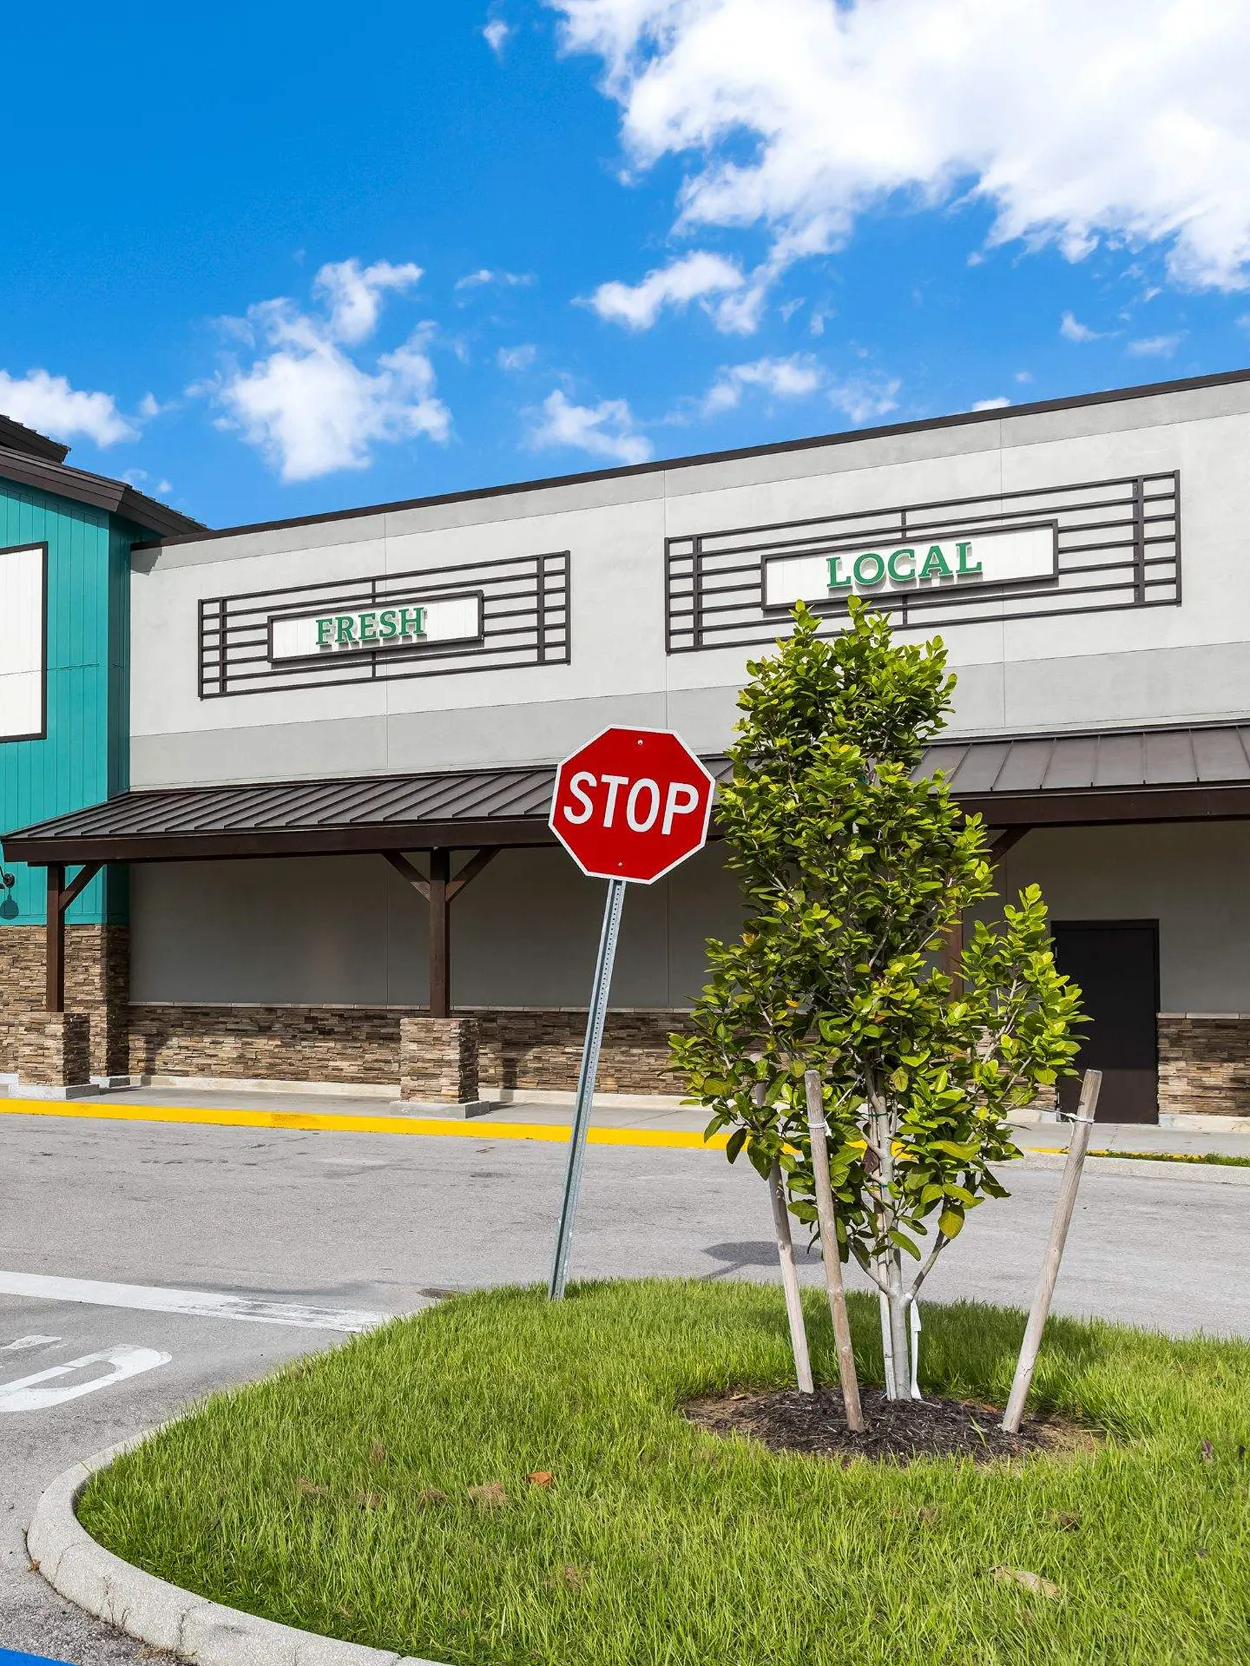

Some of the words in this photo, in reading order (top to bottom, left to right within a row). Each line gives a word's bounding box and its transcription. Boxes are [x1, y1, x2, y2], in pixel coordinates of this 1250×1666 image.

[826, 541, 983, 590] LOCAL
[316, 606, 425, 645] FRESH
[563, 771, 699, 836] STOP
